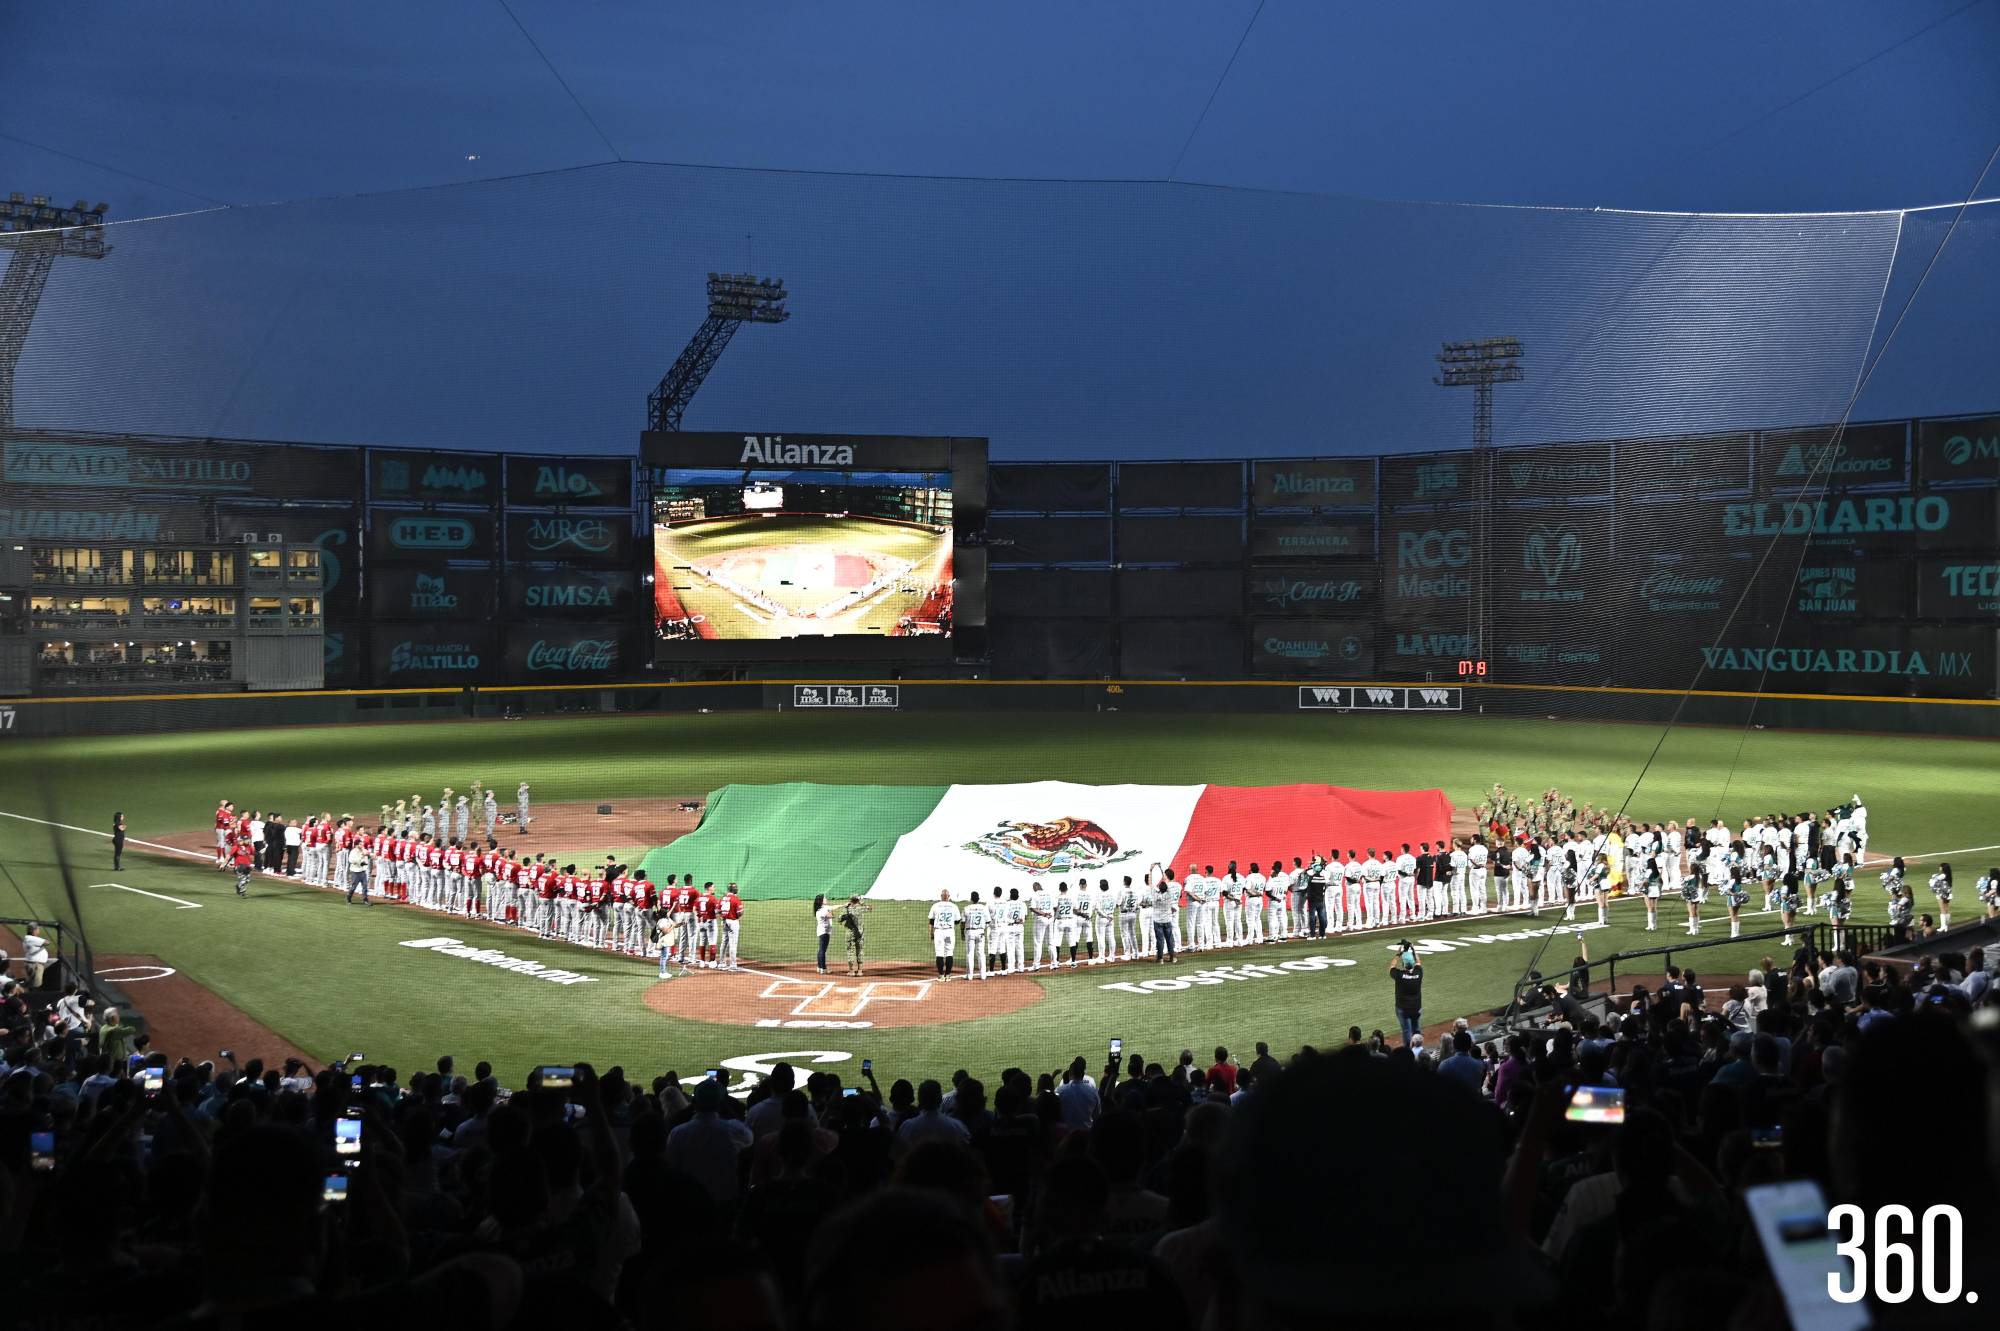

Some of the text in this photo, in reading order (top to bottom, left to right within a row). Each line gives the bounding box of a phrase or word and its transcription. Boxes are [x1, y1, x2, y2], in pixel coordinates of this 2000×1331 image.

[740, 435, 854, 465] Alianza
[136, 456, 250, 481] SALTILLO
[1273, 474, 1354, 494] Alianza
[1723, 496, 1950, 537] EL DIARIO
[1397, 528, 1472, 570] RCG
[526, 585, 613, 607] SIMSA
[1397, 573, 1471, 598] Media
[411, 592, 458, 608] mac
[1799, 599, 1857, 611] SAN JUAN
[1264, 636, 1330, 654] COAHUILA
[1700, 647, 1973, 677] VANGUARDIA MX
[1097, 955, 1358, 994] Tostitos
